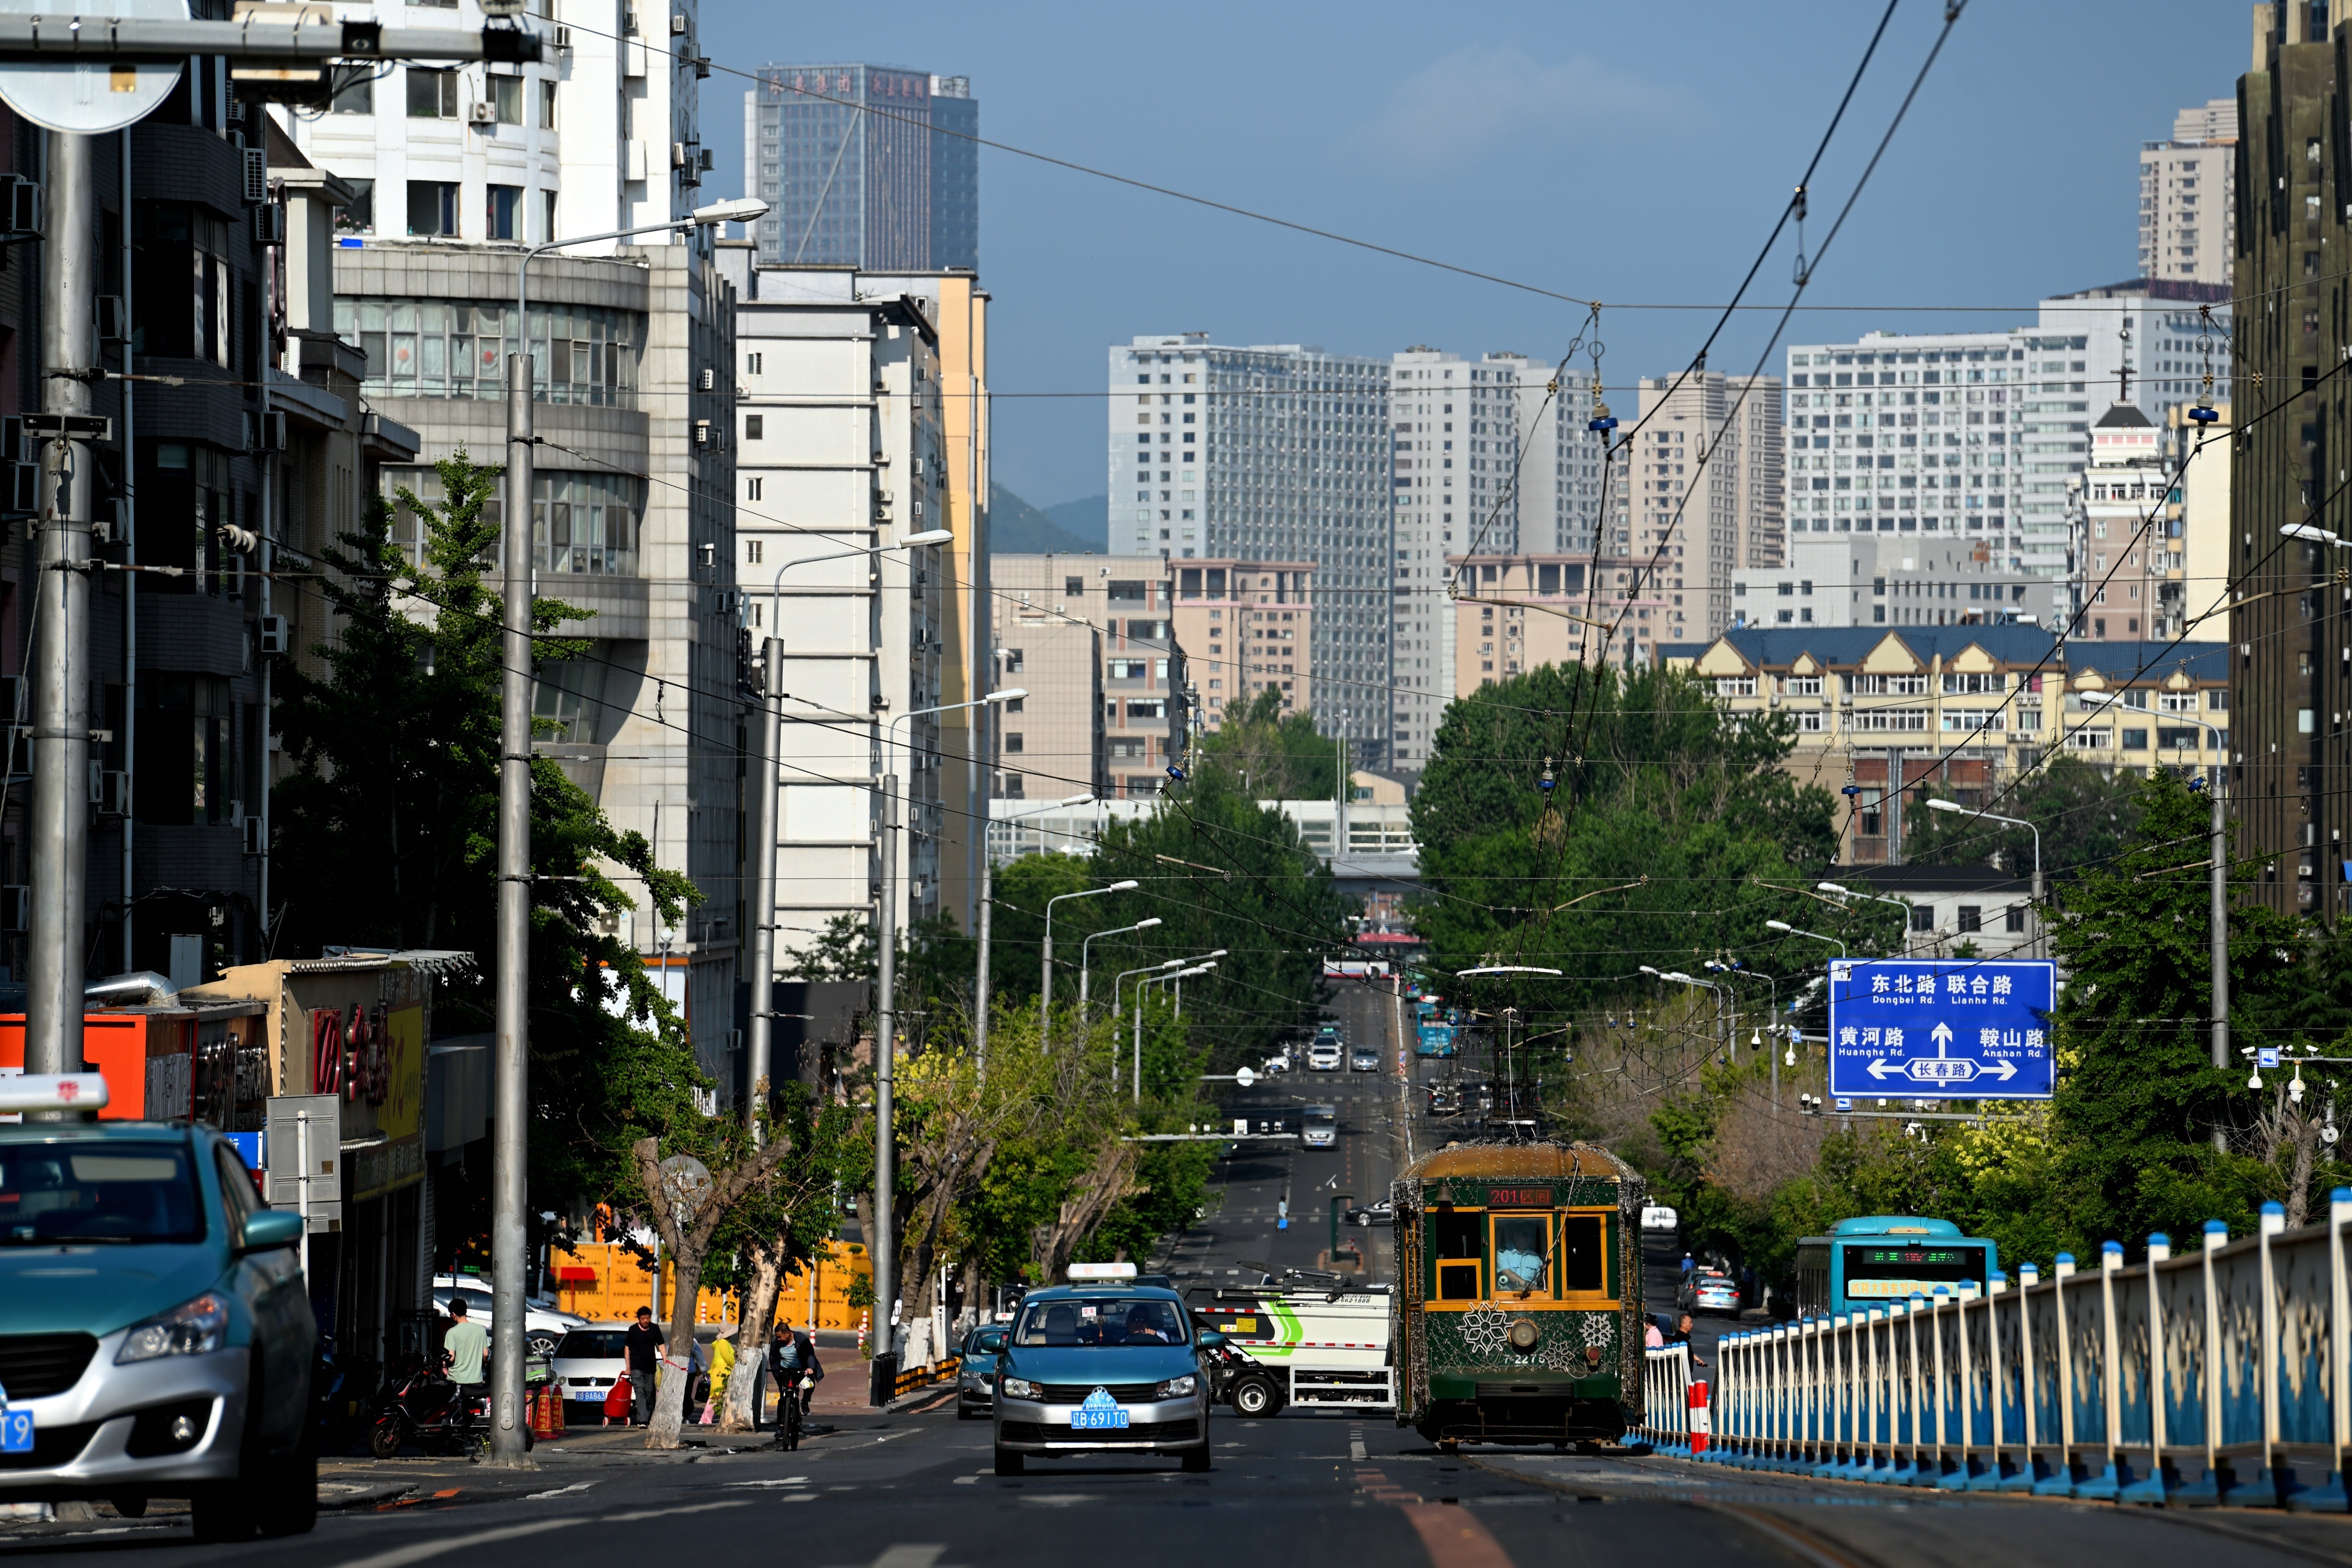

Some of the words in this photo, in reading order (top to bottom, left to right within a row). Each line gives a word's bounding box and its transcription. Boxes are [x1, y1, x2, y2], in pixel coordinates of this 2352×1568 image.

[1871, 974, 1936, 994] 东北路
[1947, 975, 2012, 995] 联合路
[1873, 996, 1914, 1005] Dongbei
[1952, 996, 1987, 1005] Lianhe
[1839, 1027, 1904, 1047] 黄河路
[1980, 1028, 2044, 1048] 鞍山路
[1839, 1048, 1884, 1057] Huanghe
[1890, 1048, 1905, 1057] Rd.
[1983, 1049, 2022, 1057] Anshan
[2028, 1049, 2043, 1057] Rd.
[1918, 1063, 1966, 1076] 长春路
